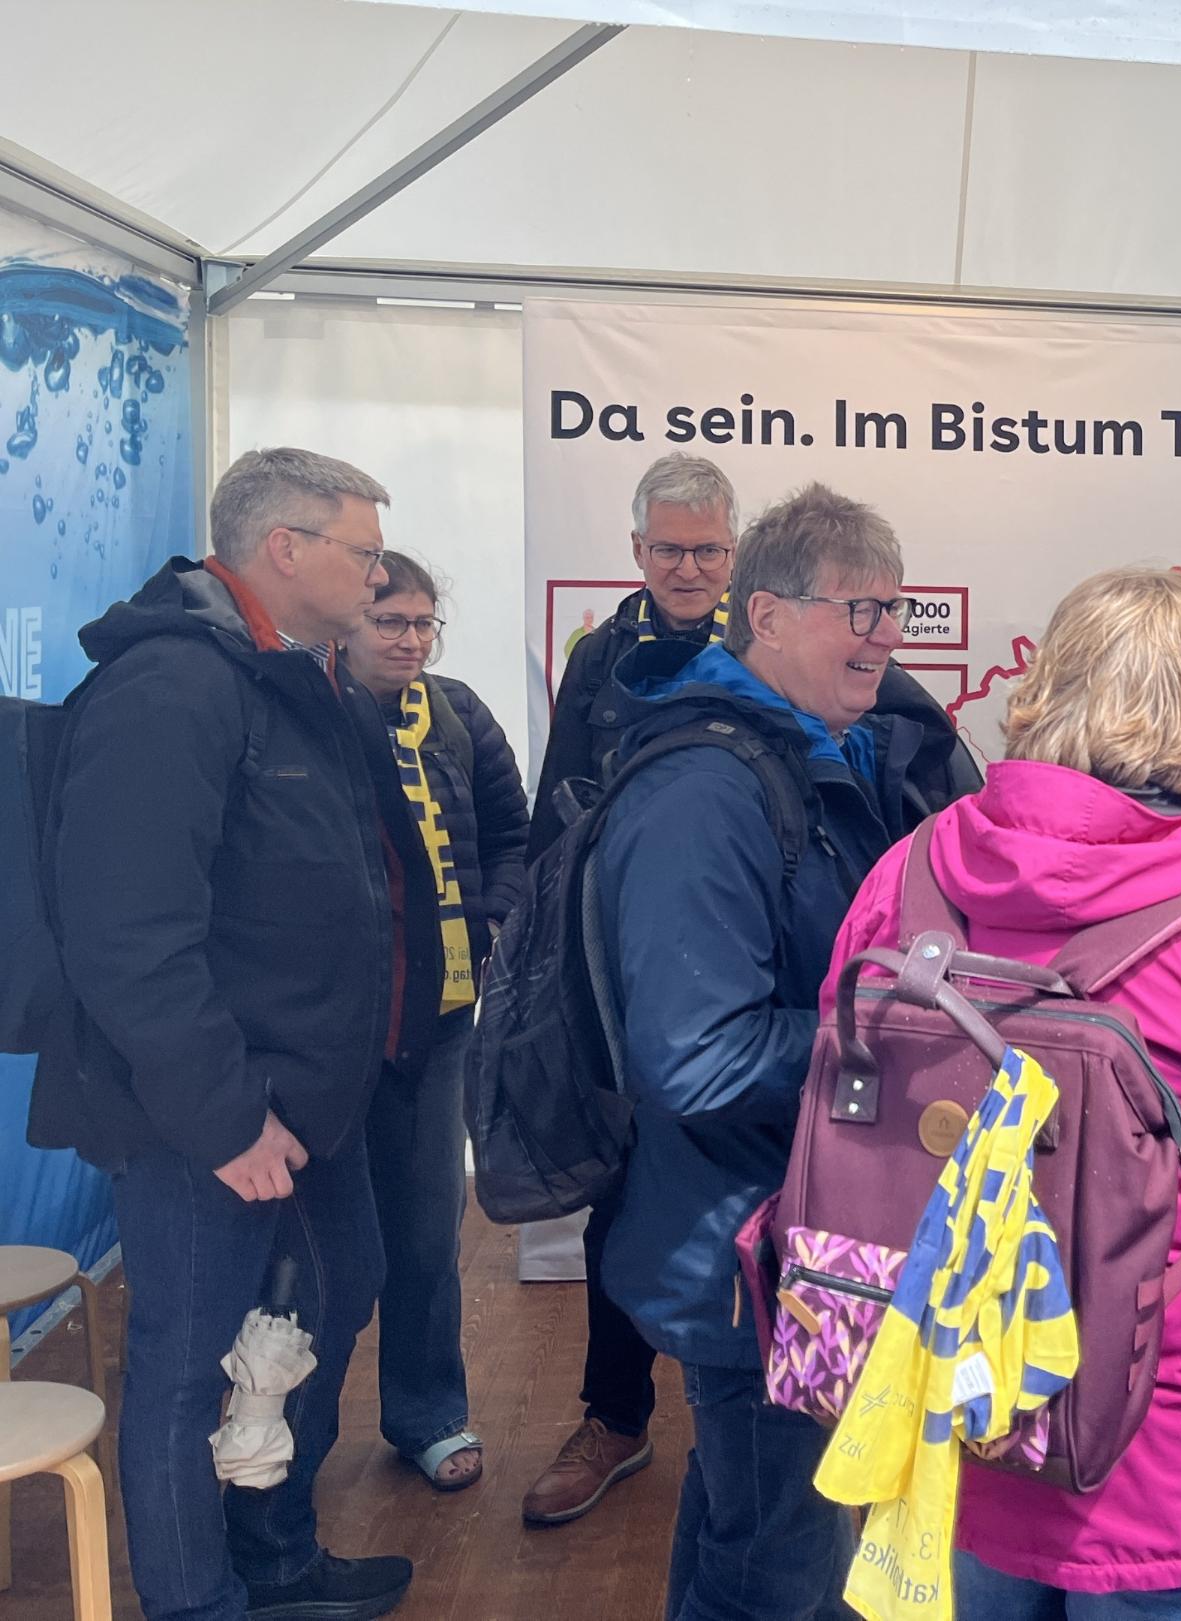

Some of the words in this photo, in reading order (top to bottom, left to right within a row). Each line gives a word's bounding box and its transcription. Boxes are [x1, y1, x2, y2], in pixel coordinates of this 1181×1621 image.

[550, 390, 645, 441] Da
[665, 393, 814, 447] sein.
[835, 399, 907, 449] Im
[931, 401, 1143, 456] Bistum
